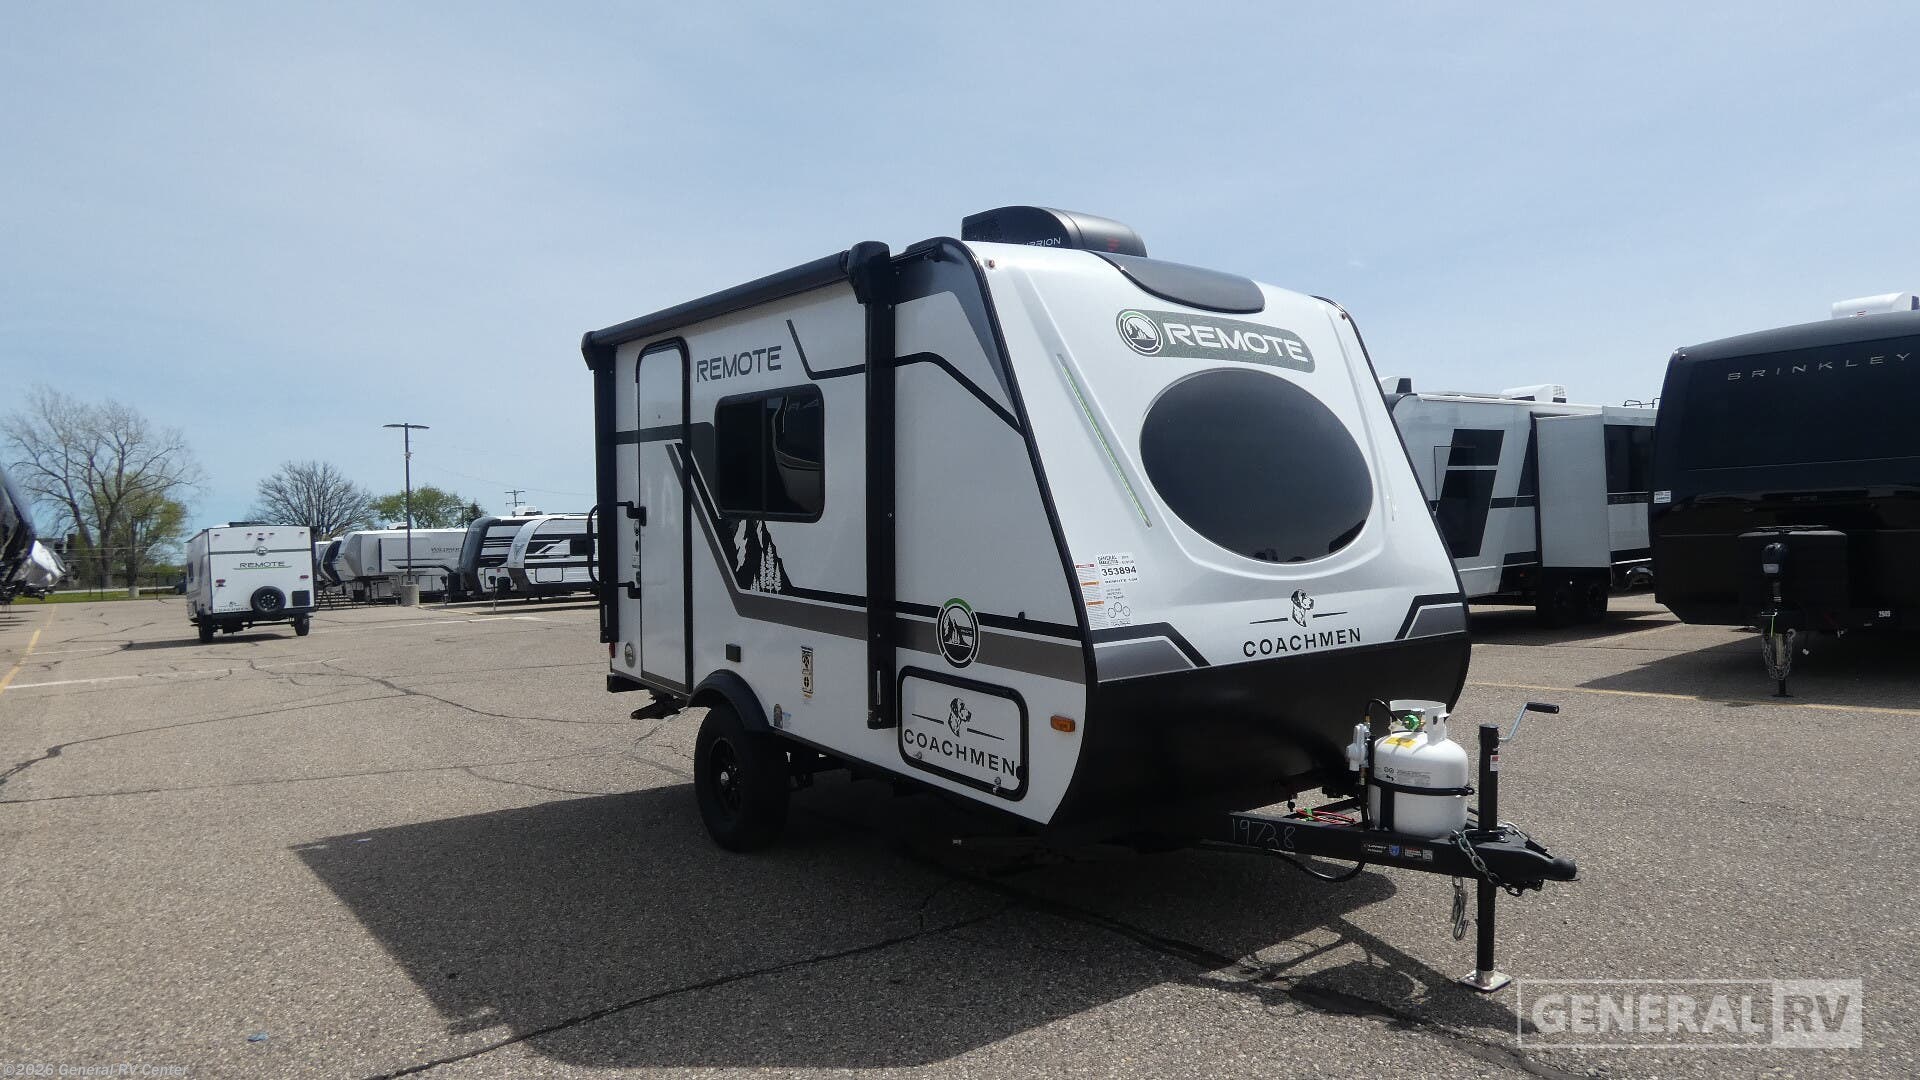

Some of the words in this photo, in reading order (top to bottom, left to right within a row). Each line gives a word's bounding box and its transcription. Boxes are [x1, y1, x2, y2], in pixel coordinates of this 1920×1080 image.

[1162, 322, 1309, 363] REMOTE
[696, 345, 782, 383] REMOTE
[1727, 352, 1911, 381] BRINKLEY
[1101, 565, 1137, 577] 353894
[1243, 627, 1361, 657] COACHMEN
[904, 728, 1015, 777] COACHMEN
